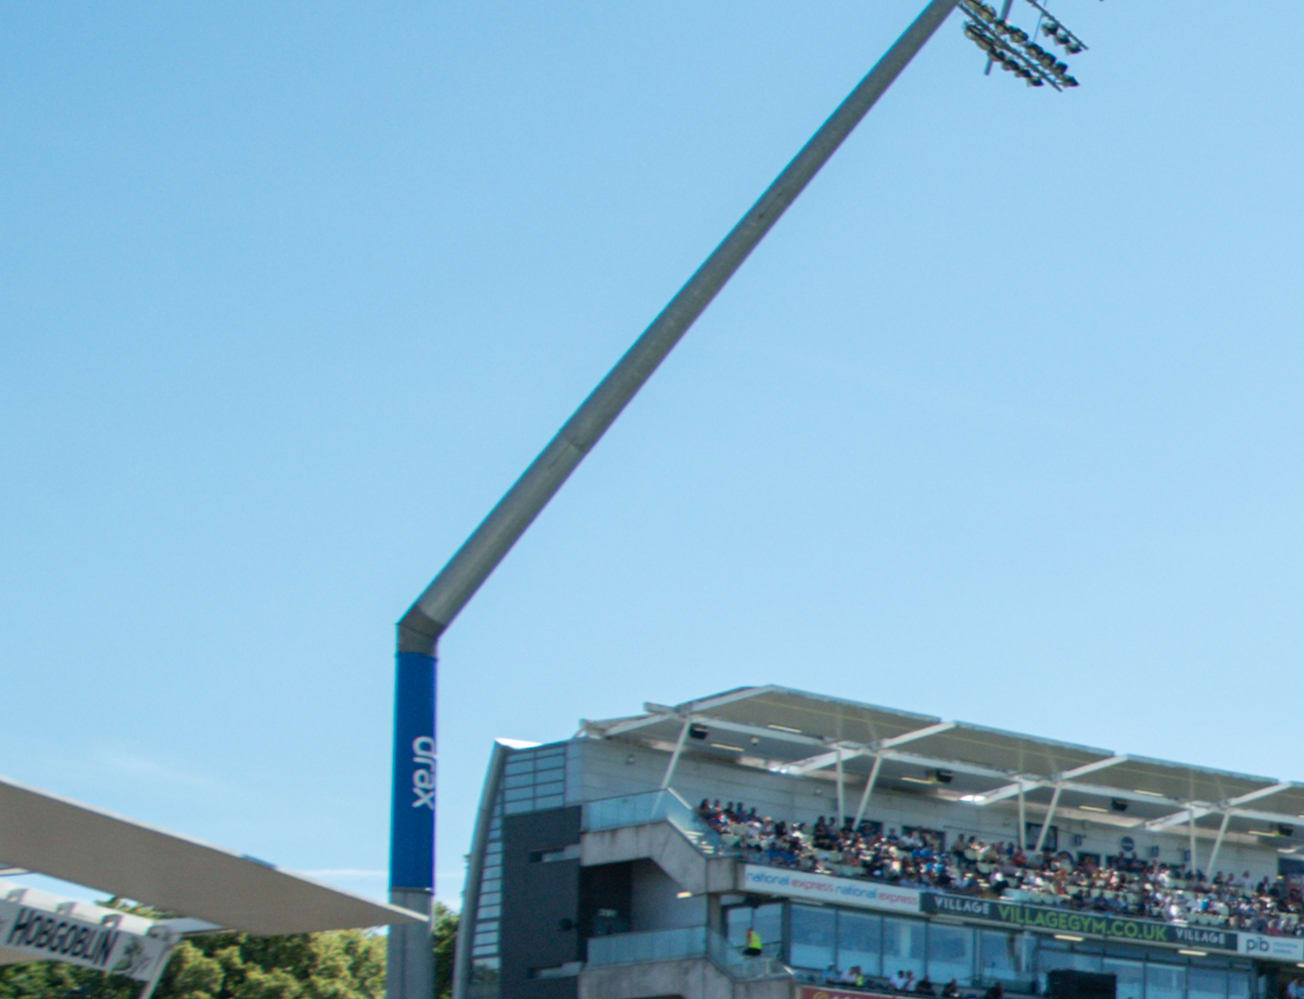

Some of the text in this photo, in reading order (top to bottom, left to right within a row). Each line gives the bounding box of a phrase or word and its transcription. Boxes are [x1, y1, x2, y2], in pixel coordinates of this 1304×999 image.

[412, 736, 436, 810] drax
[934, 896, 990, 915] VILLAGE
[998, 905, 1167, 941] VILLAGEGYM.CO.UK
[6, 906, 119, 967] HOBGOBLIN
[1176, 928, 1225, 945] VILLAGE
